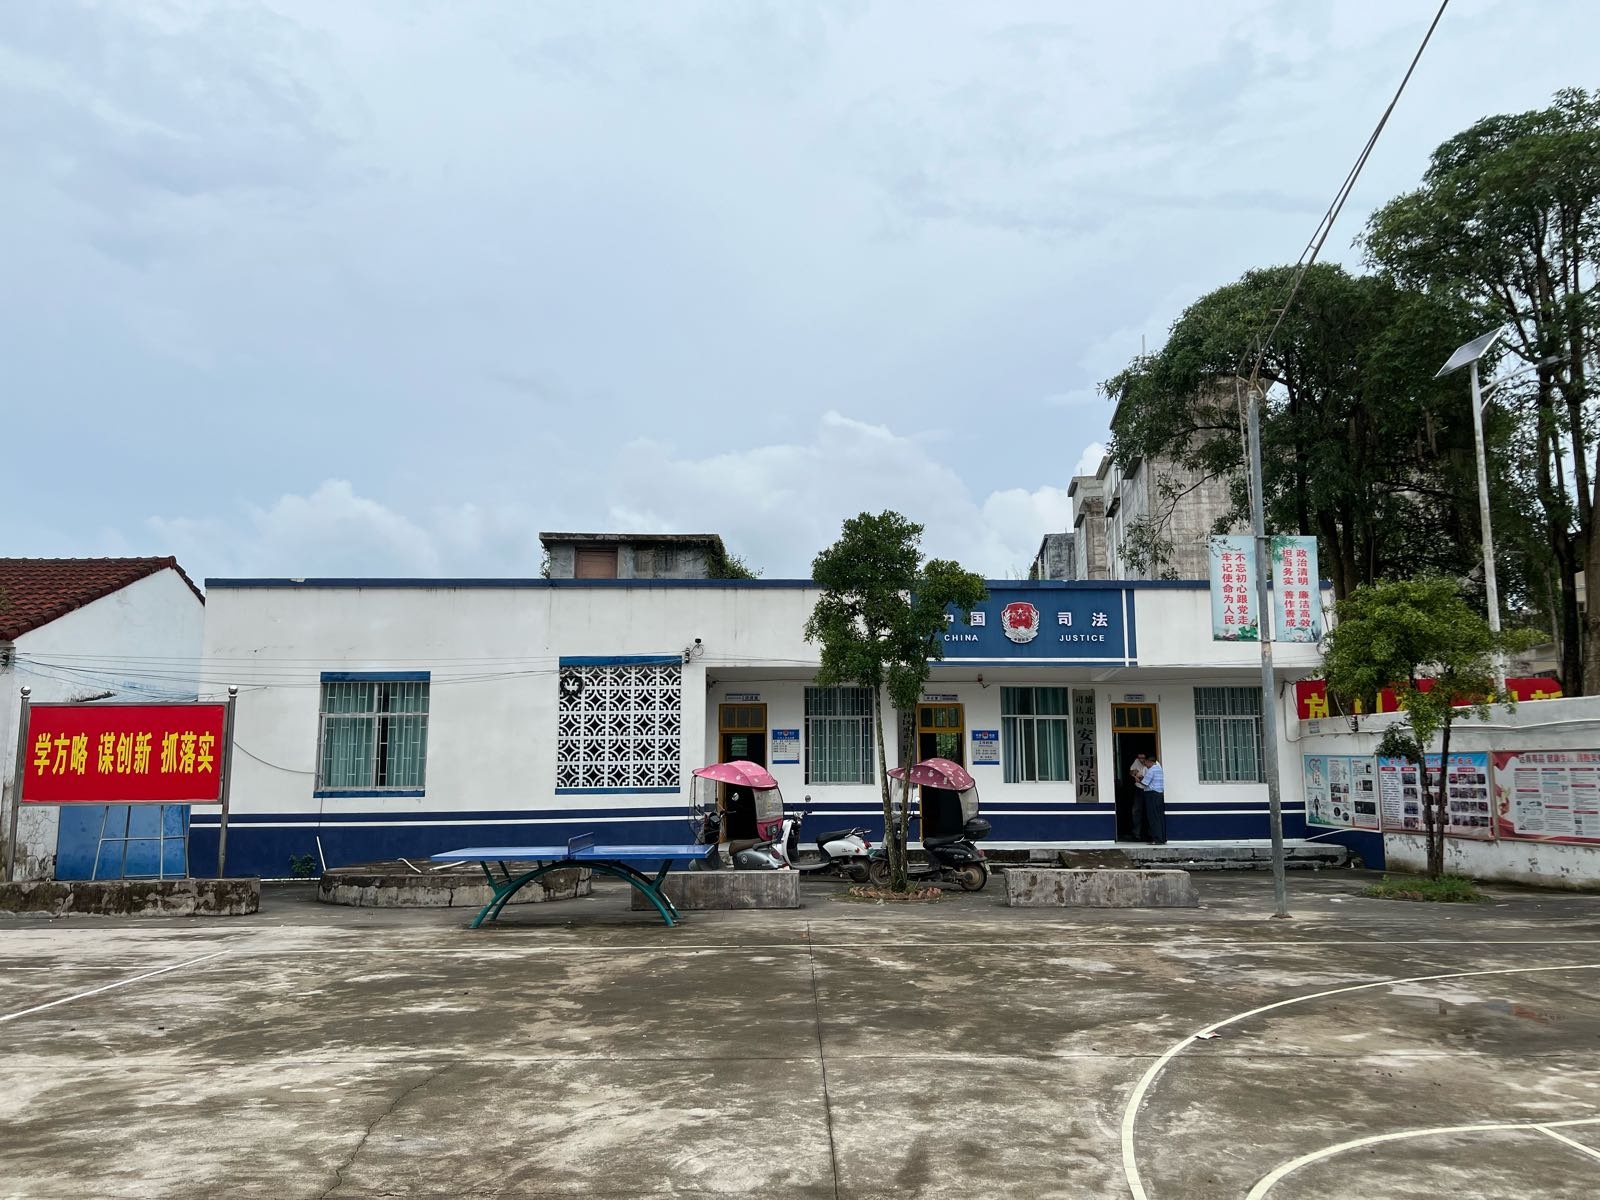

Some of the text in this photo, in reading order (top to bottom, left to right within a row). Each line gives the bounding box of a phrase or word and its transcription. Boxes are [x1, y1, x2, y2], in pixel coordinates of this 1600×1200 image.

[1057, 611, 1108, 627] 司法
[1221, 552, 1235, 625] 牢记使命为人民
[1235, 552, 1248, 625] 不忘初心跟党走
[1282, 549, 1297, 627] 担当务实 善作善成
[1296, 549, 1311, 627] 政治清明 廉洁高效
[944, 634, 1105, 642] CHINA JUSTICE
[33, 731, 215, 775] 学方略 谋创新 抓落实
[1077, 728, 1096, 797] 安石司法所
